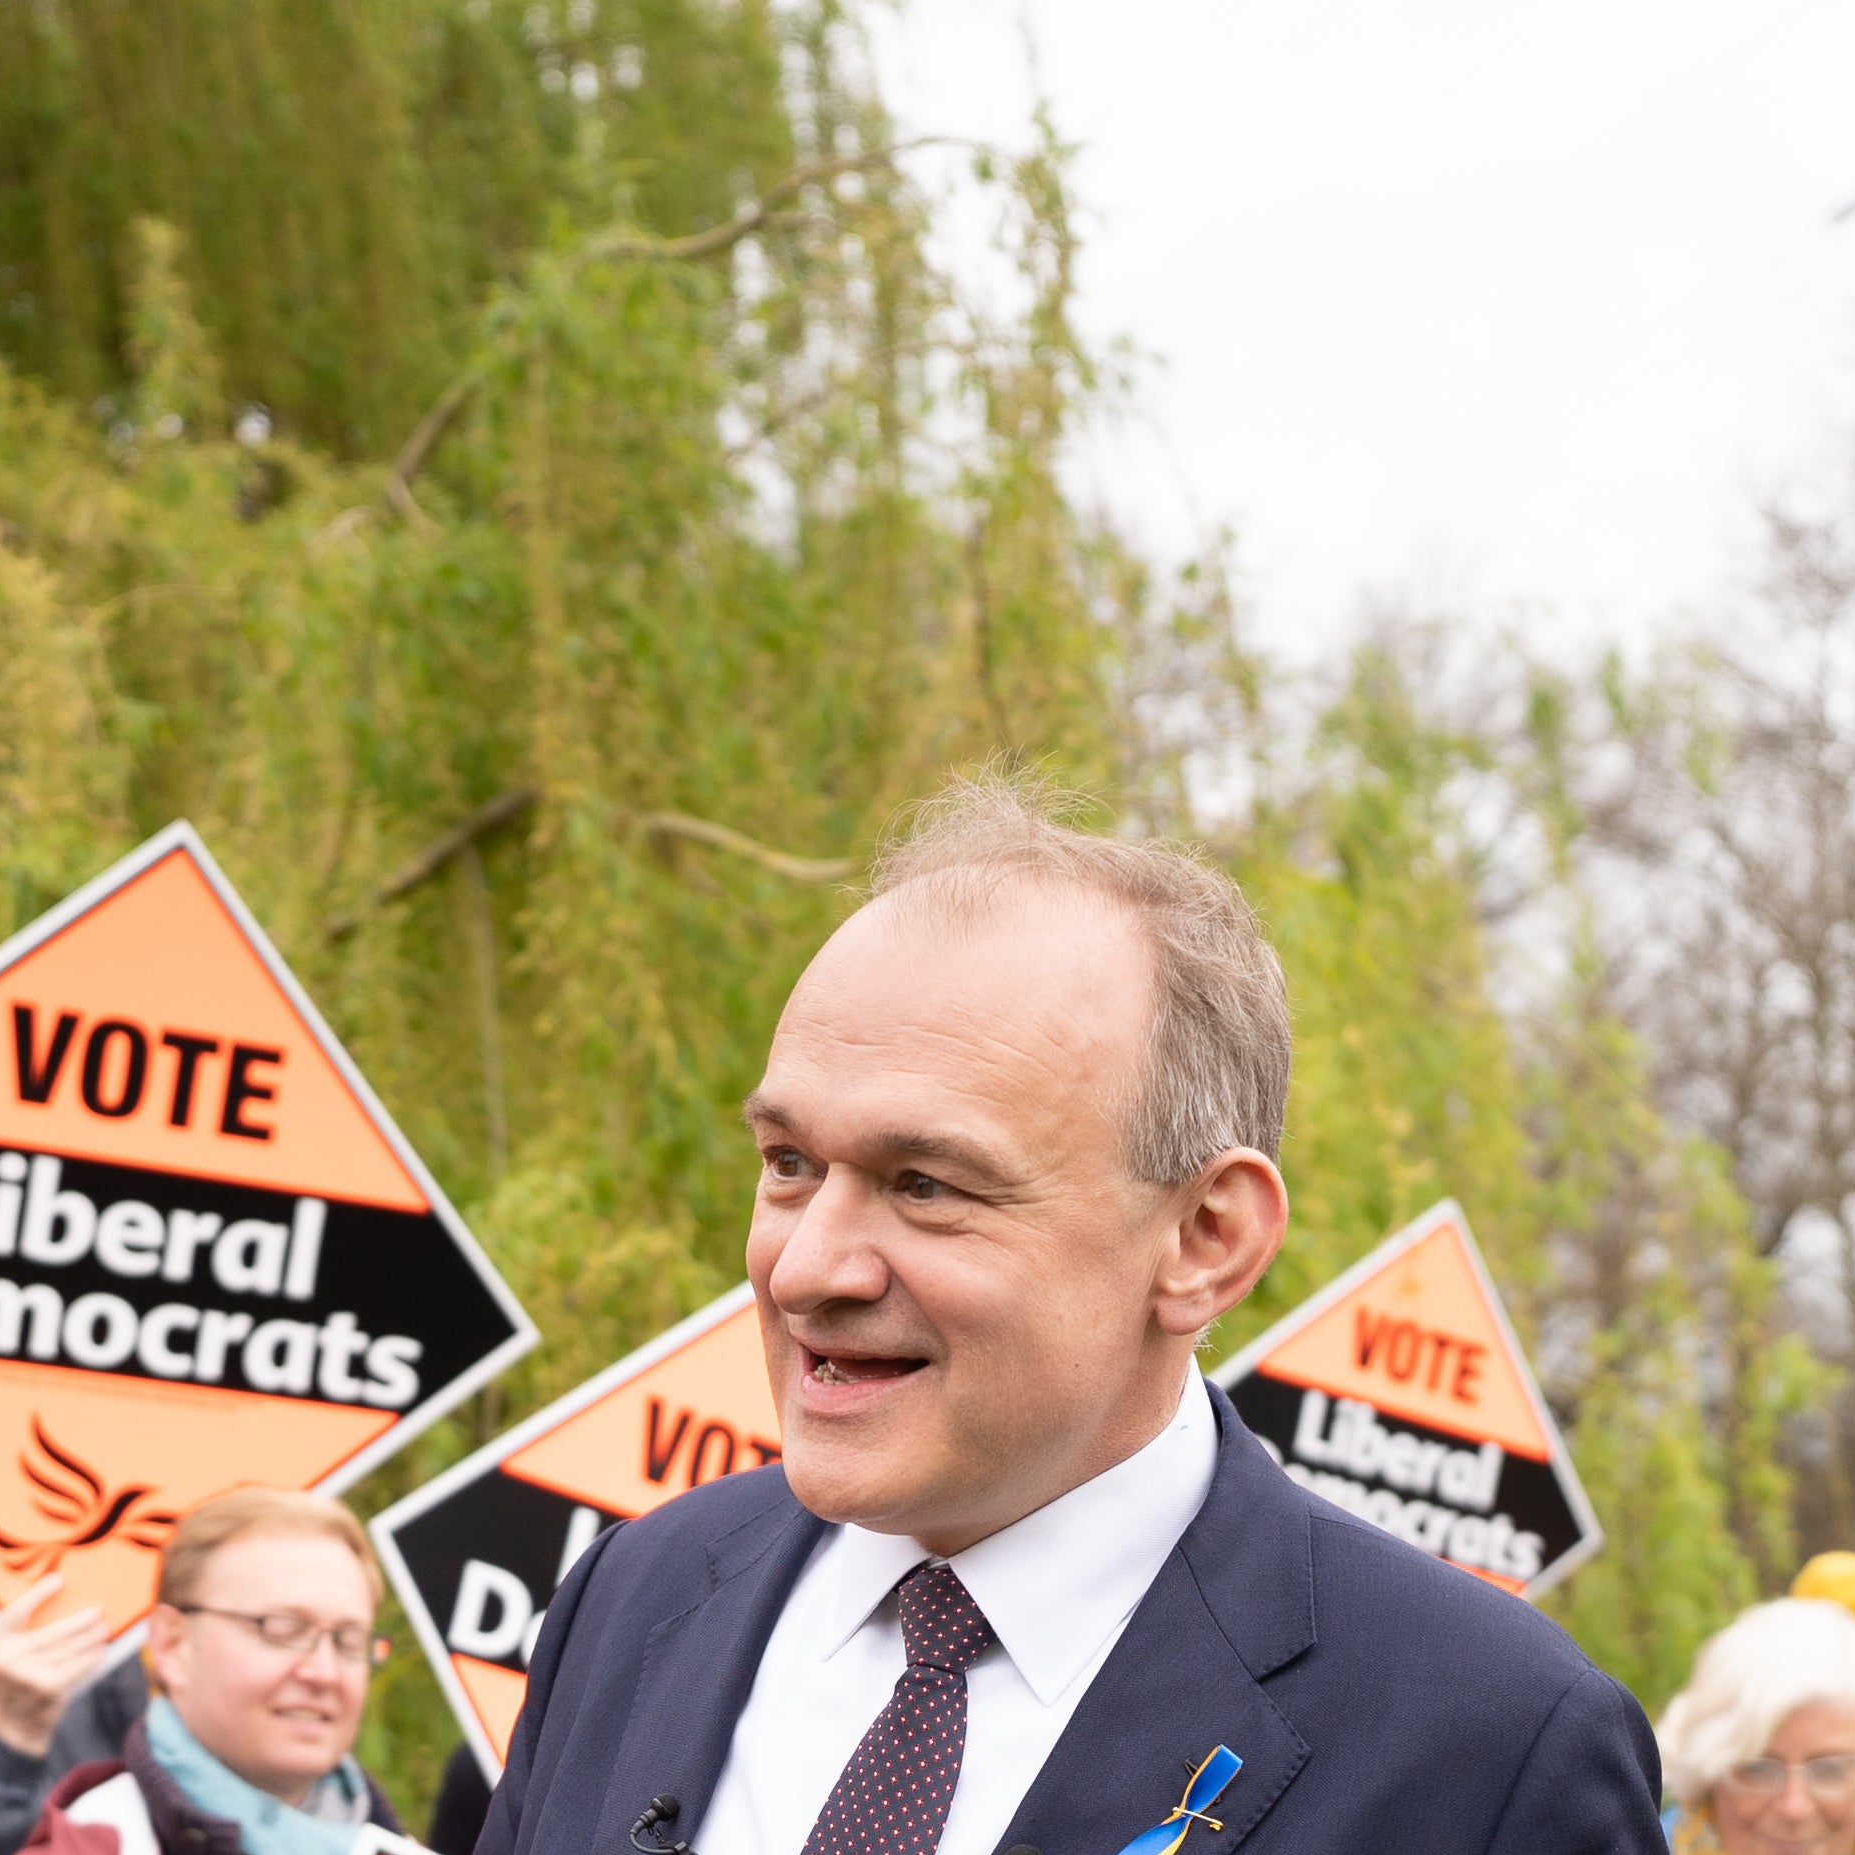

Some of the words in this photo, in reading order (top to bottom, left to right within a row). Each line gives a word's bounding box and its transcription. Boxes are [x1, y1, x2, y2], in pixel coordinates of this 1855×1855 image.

[9, 1002, 285, 1144] VOTE
[1353, 1305, 1487, 1407] VOTE
[1293, 1387, 1507, 1514] Liberal
